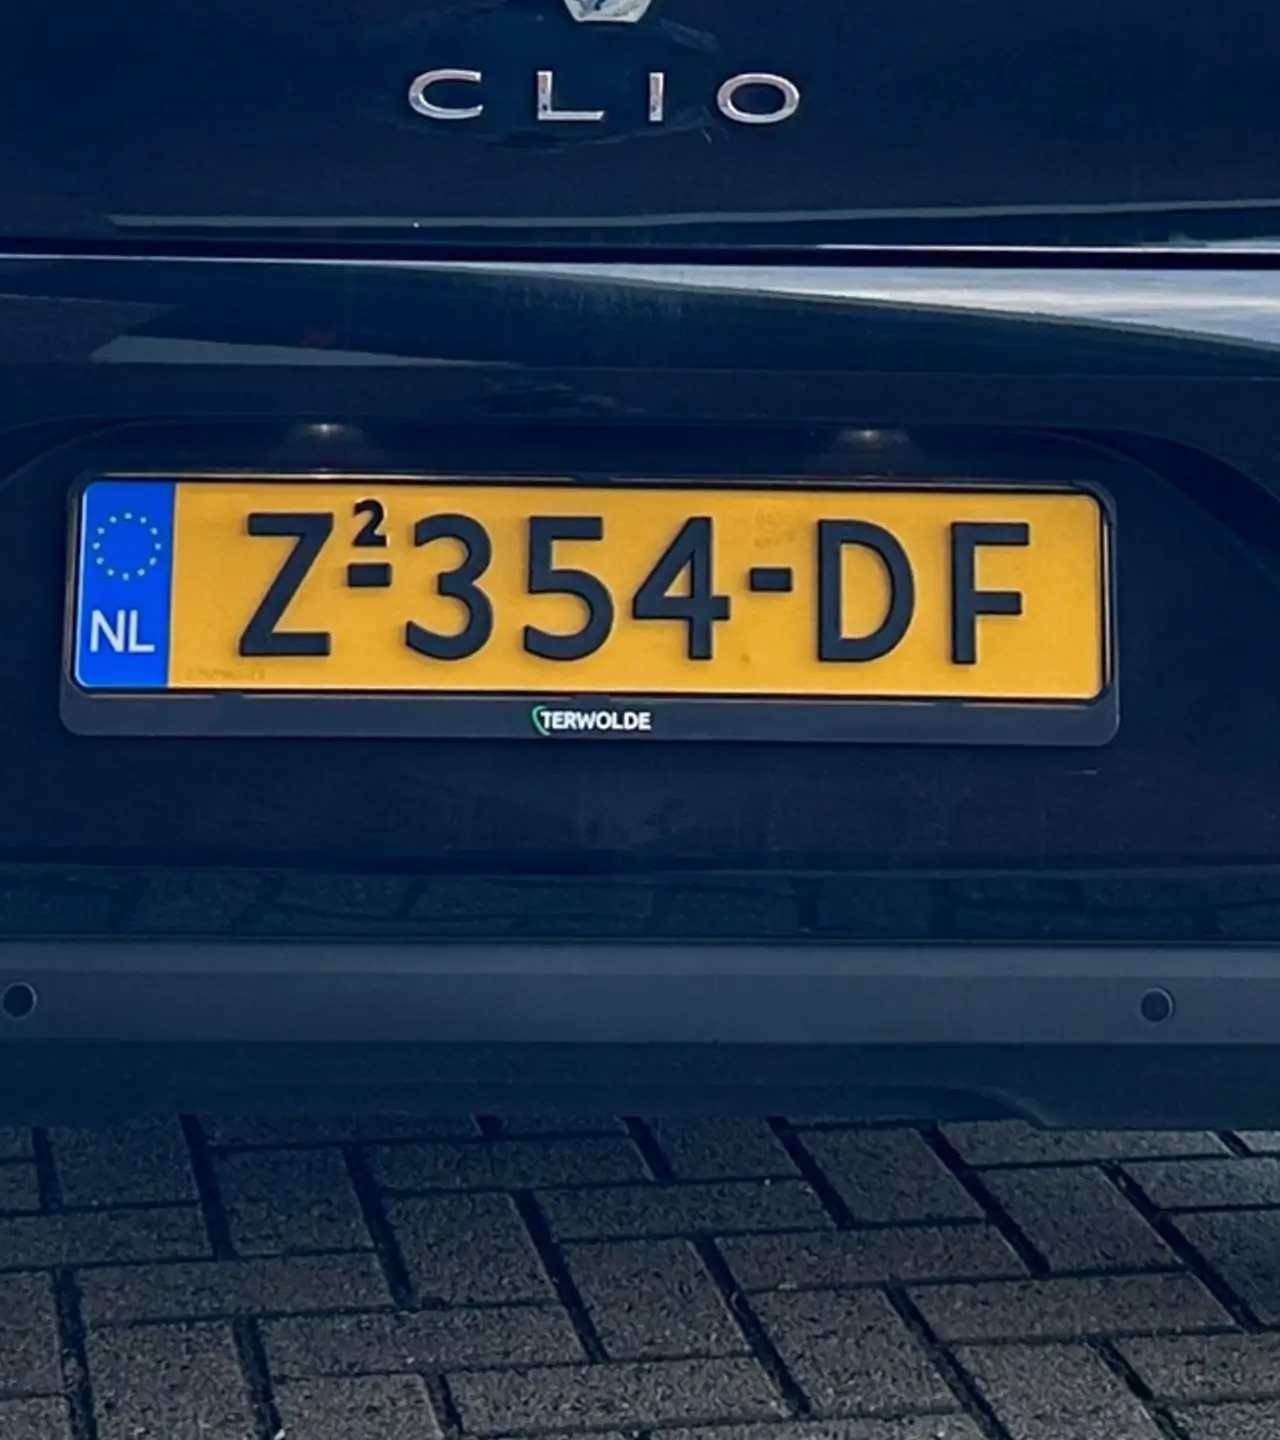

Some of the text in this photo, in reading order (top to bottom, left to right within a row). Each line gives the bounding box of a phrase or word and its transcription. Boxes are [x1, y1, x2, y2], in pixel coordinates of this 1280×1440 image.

[408, 69, 800, 124] CLIO
[89, 608, 156, 653] NL
[540, 710, 652, 731] TERWOLDE
